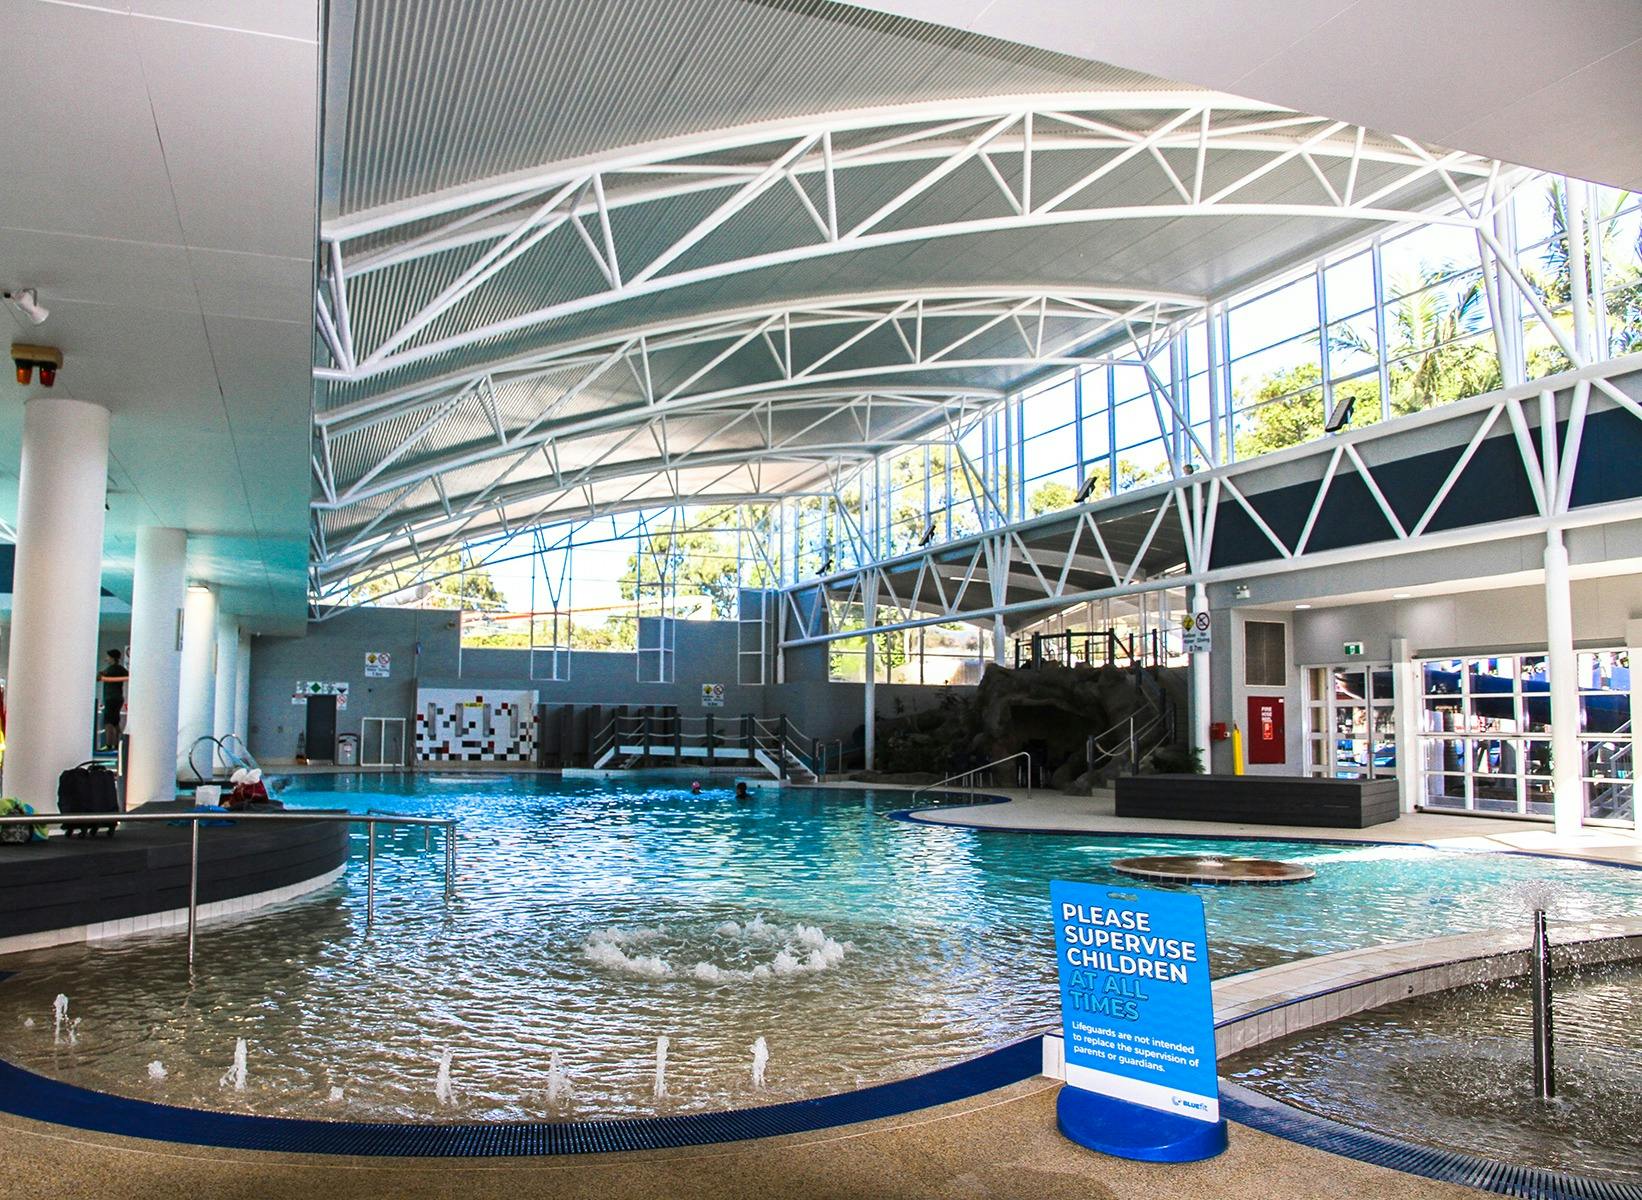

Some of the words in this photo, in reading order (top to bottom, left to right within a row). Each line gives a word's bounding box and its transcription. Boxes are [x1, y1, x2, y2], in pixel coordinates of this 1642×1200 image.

[1062, 903, 1151, 932] PLEASE
[1064, 925, 1197, 962] SUPERVISE
[1066, 947, 1189, 984] CHILDREN
[1070, 969, 1097, 990] AT
[1104, 975, 1149, 1000] ALL
[1070, 990, 1140, 1021] TIMES
[1072, 1021, 1116, 1038] Lifeguards
[1118, 1030, 1133, 1041] are
[1134, 1035, 1151, 1046] not
[1152, 1037, 1195, 1055] intended
[1073, 1032, 1083, 1042] to
[1084, 1035, 1116, 1050] replace
[1117, 1042, 1133, 1053] the
[1134, 1046, 1187, 1066] supervision
[1188, 1058, 1200, 1068] of
[1074, 1045, 1106, 1059] parents
[1107, 1053, 1117, 1061] or
[1118, 1055, 1166, 1073] guardians.
